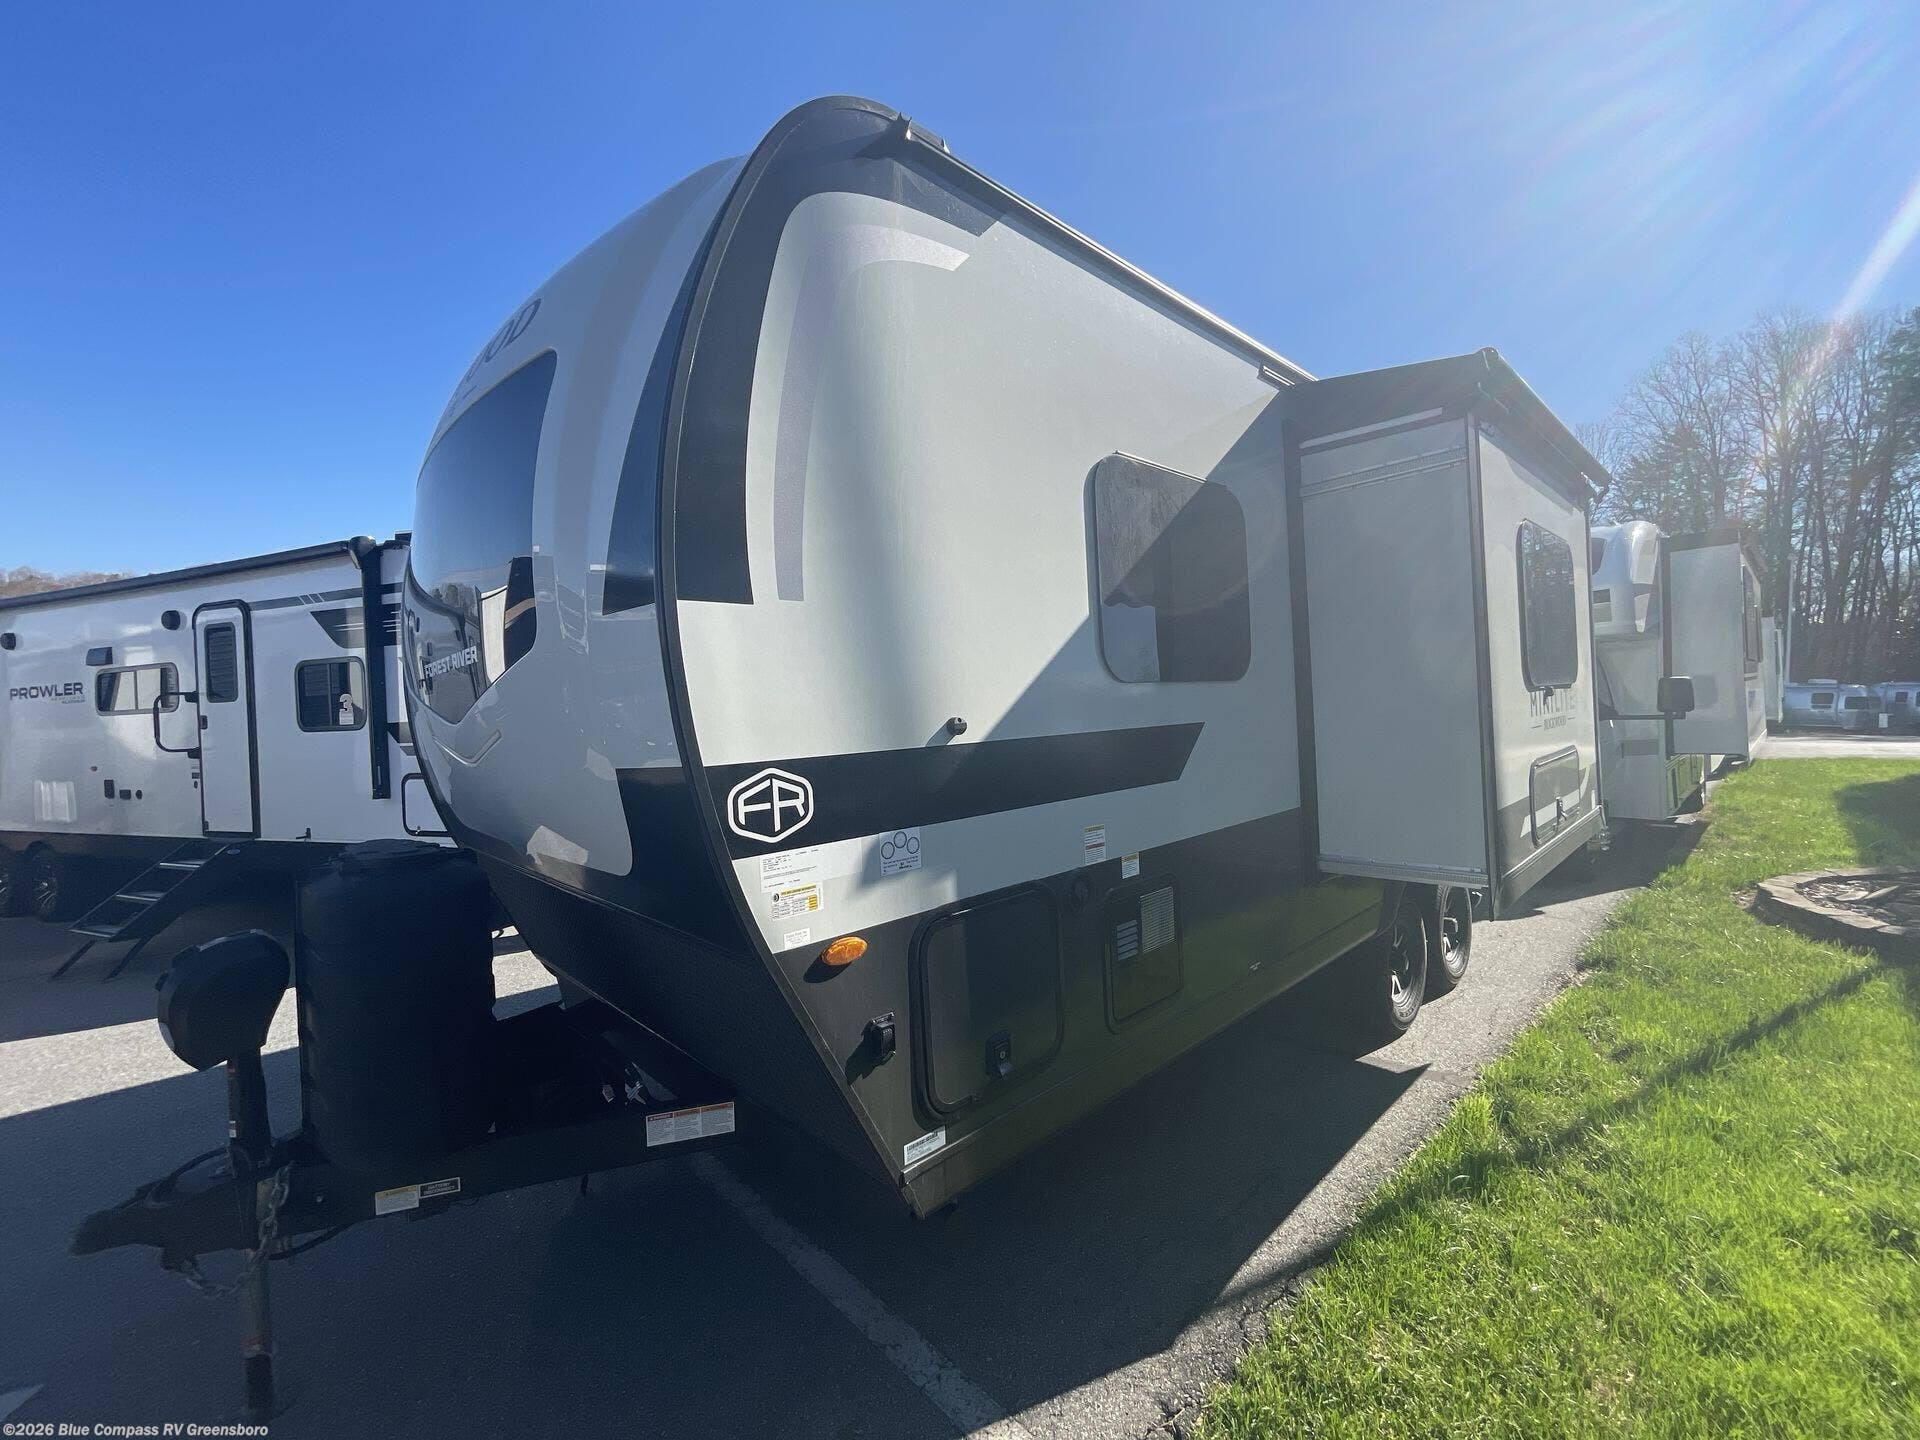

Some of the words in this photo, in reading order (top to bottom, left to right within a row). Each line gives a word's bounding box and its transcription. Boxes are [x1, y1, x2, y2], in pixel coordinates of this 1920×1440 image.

[424, 656, 450, 678] FOREST
[451, 646, 477, 669] RIVER
[10, 682, 83, 700] PROWLER
[738, 778, 805, 832] FR
